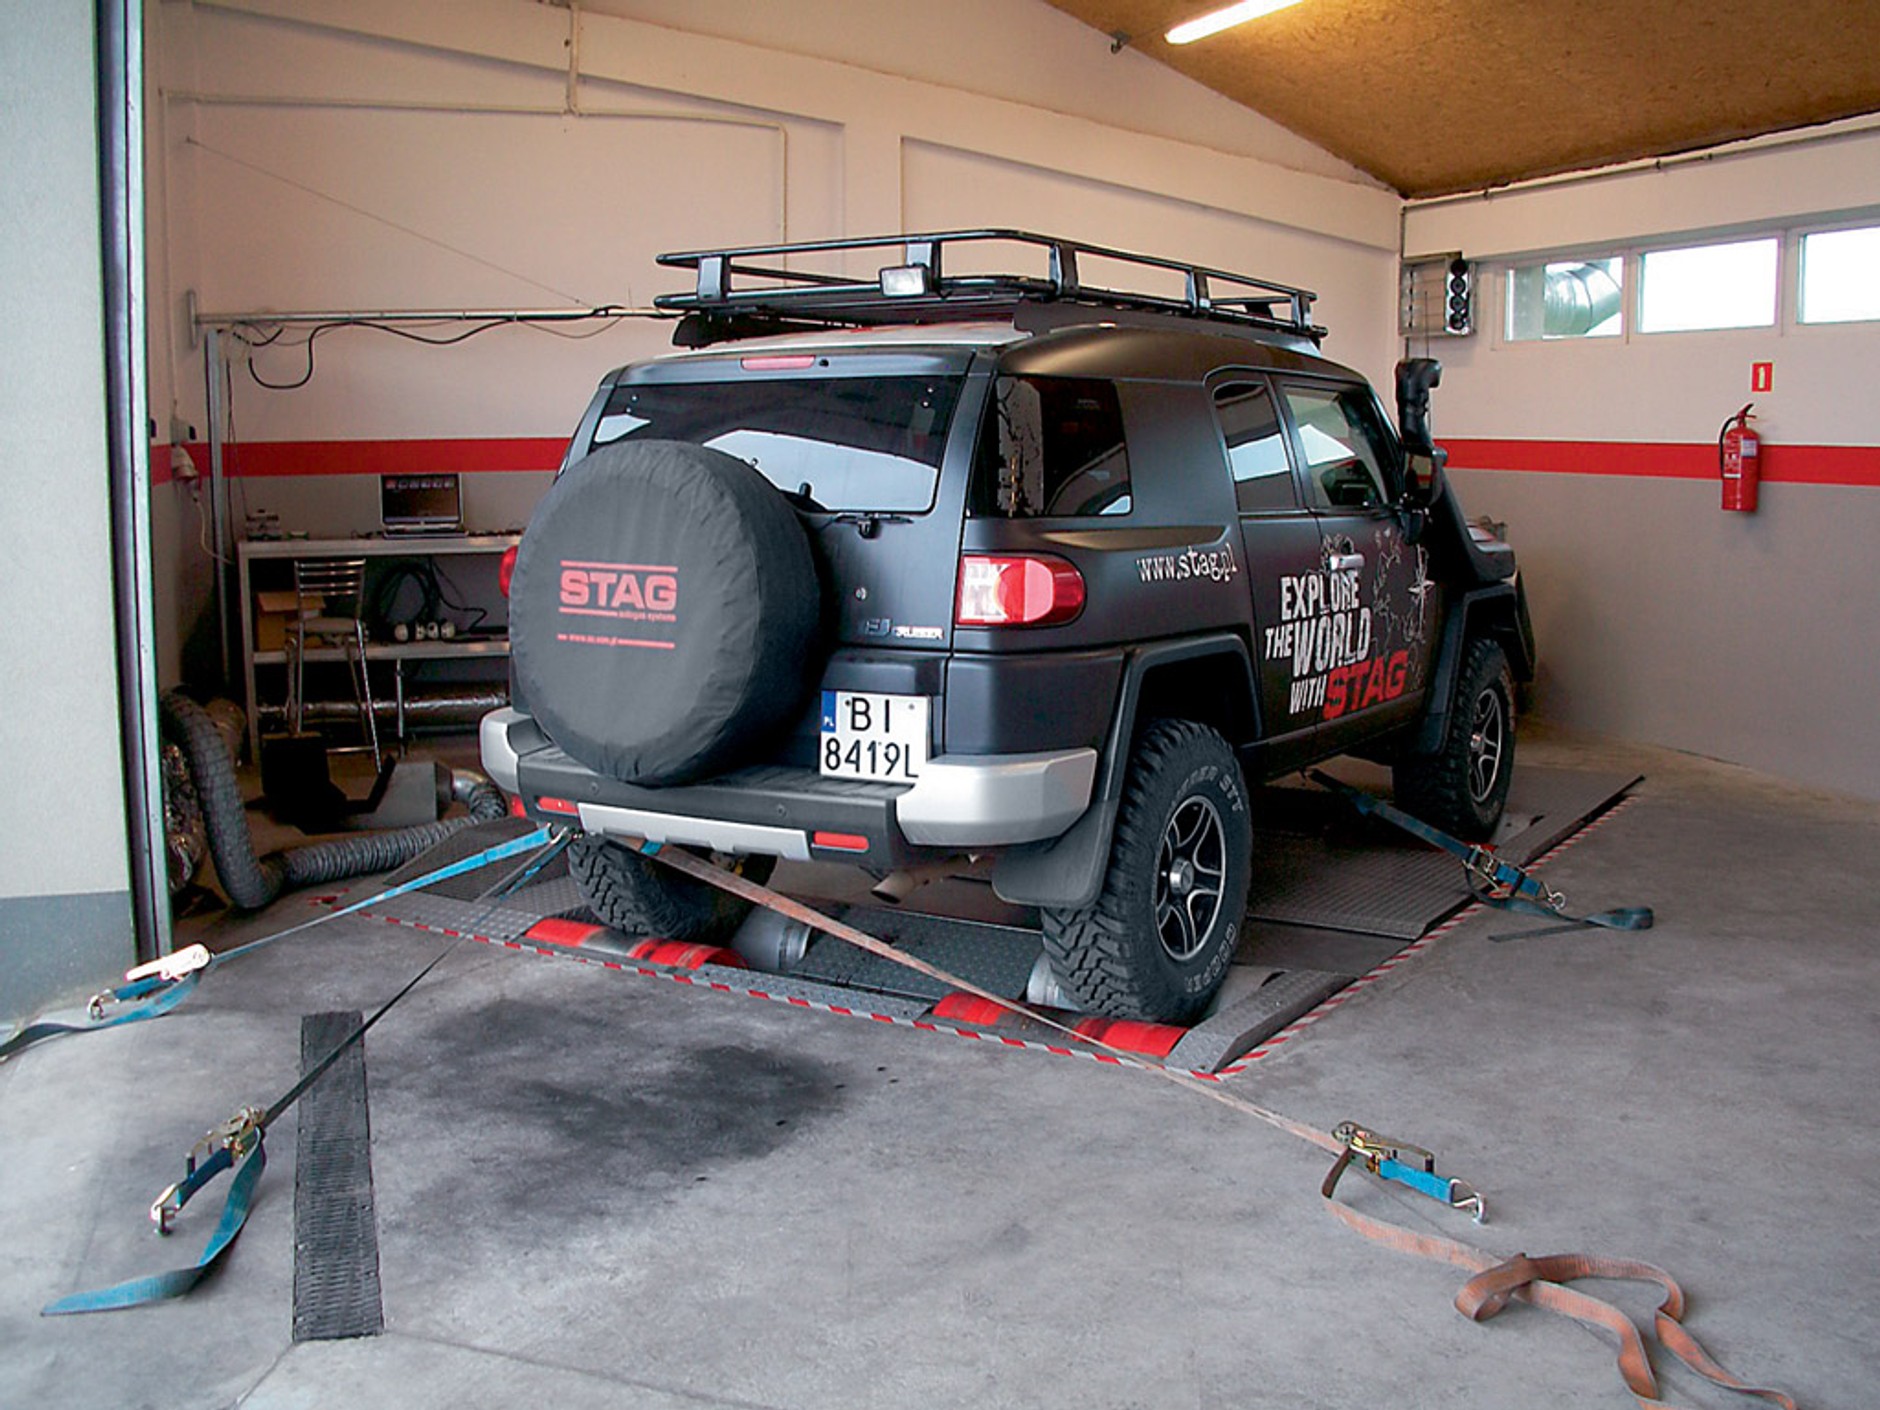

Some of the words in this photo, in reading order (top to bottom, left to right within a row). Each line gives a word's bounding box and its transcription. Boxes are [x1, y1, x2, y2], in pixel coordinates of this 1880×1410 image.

[1136, 542, 1237, 582] www.stag.pl
[560, 569, 678, 611] STAG
[1280, 570, 1360, 621] EXPLORE
[1265, 624, 1293, 660] THE
[1293, 607, 1371, 677] WORLD
[1289, 674, 1327, 715] WITH
[1322, 650, 1408, 720] STAG
[825, 737, 919, 778] 8419L
